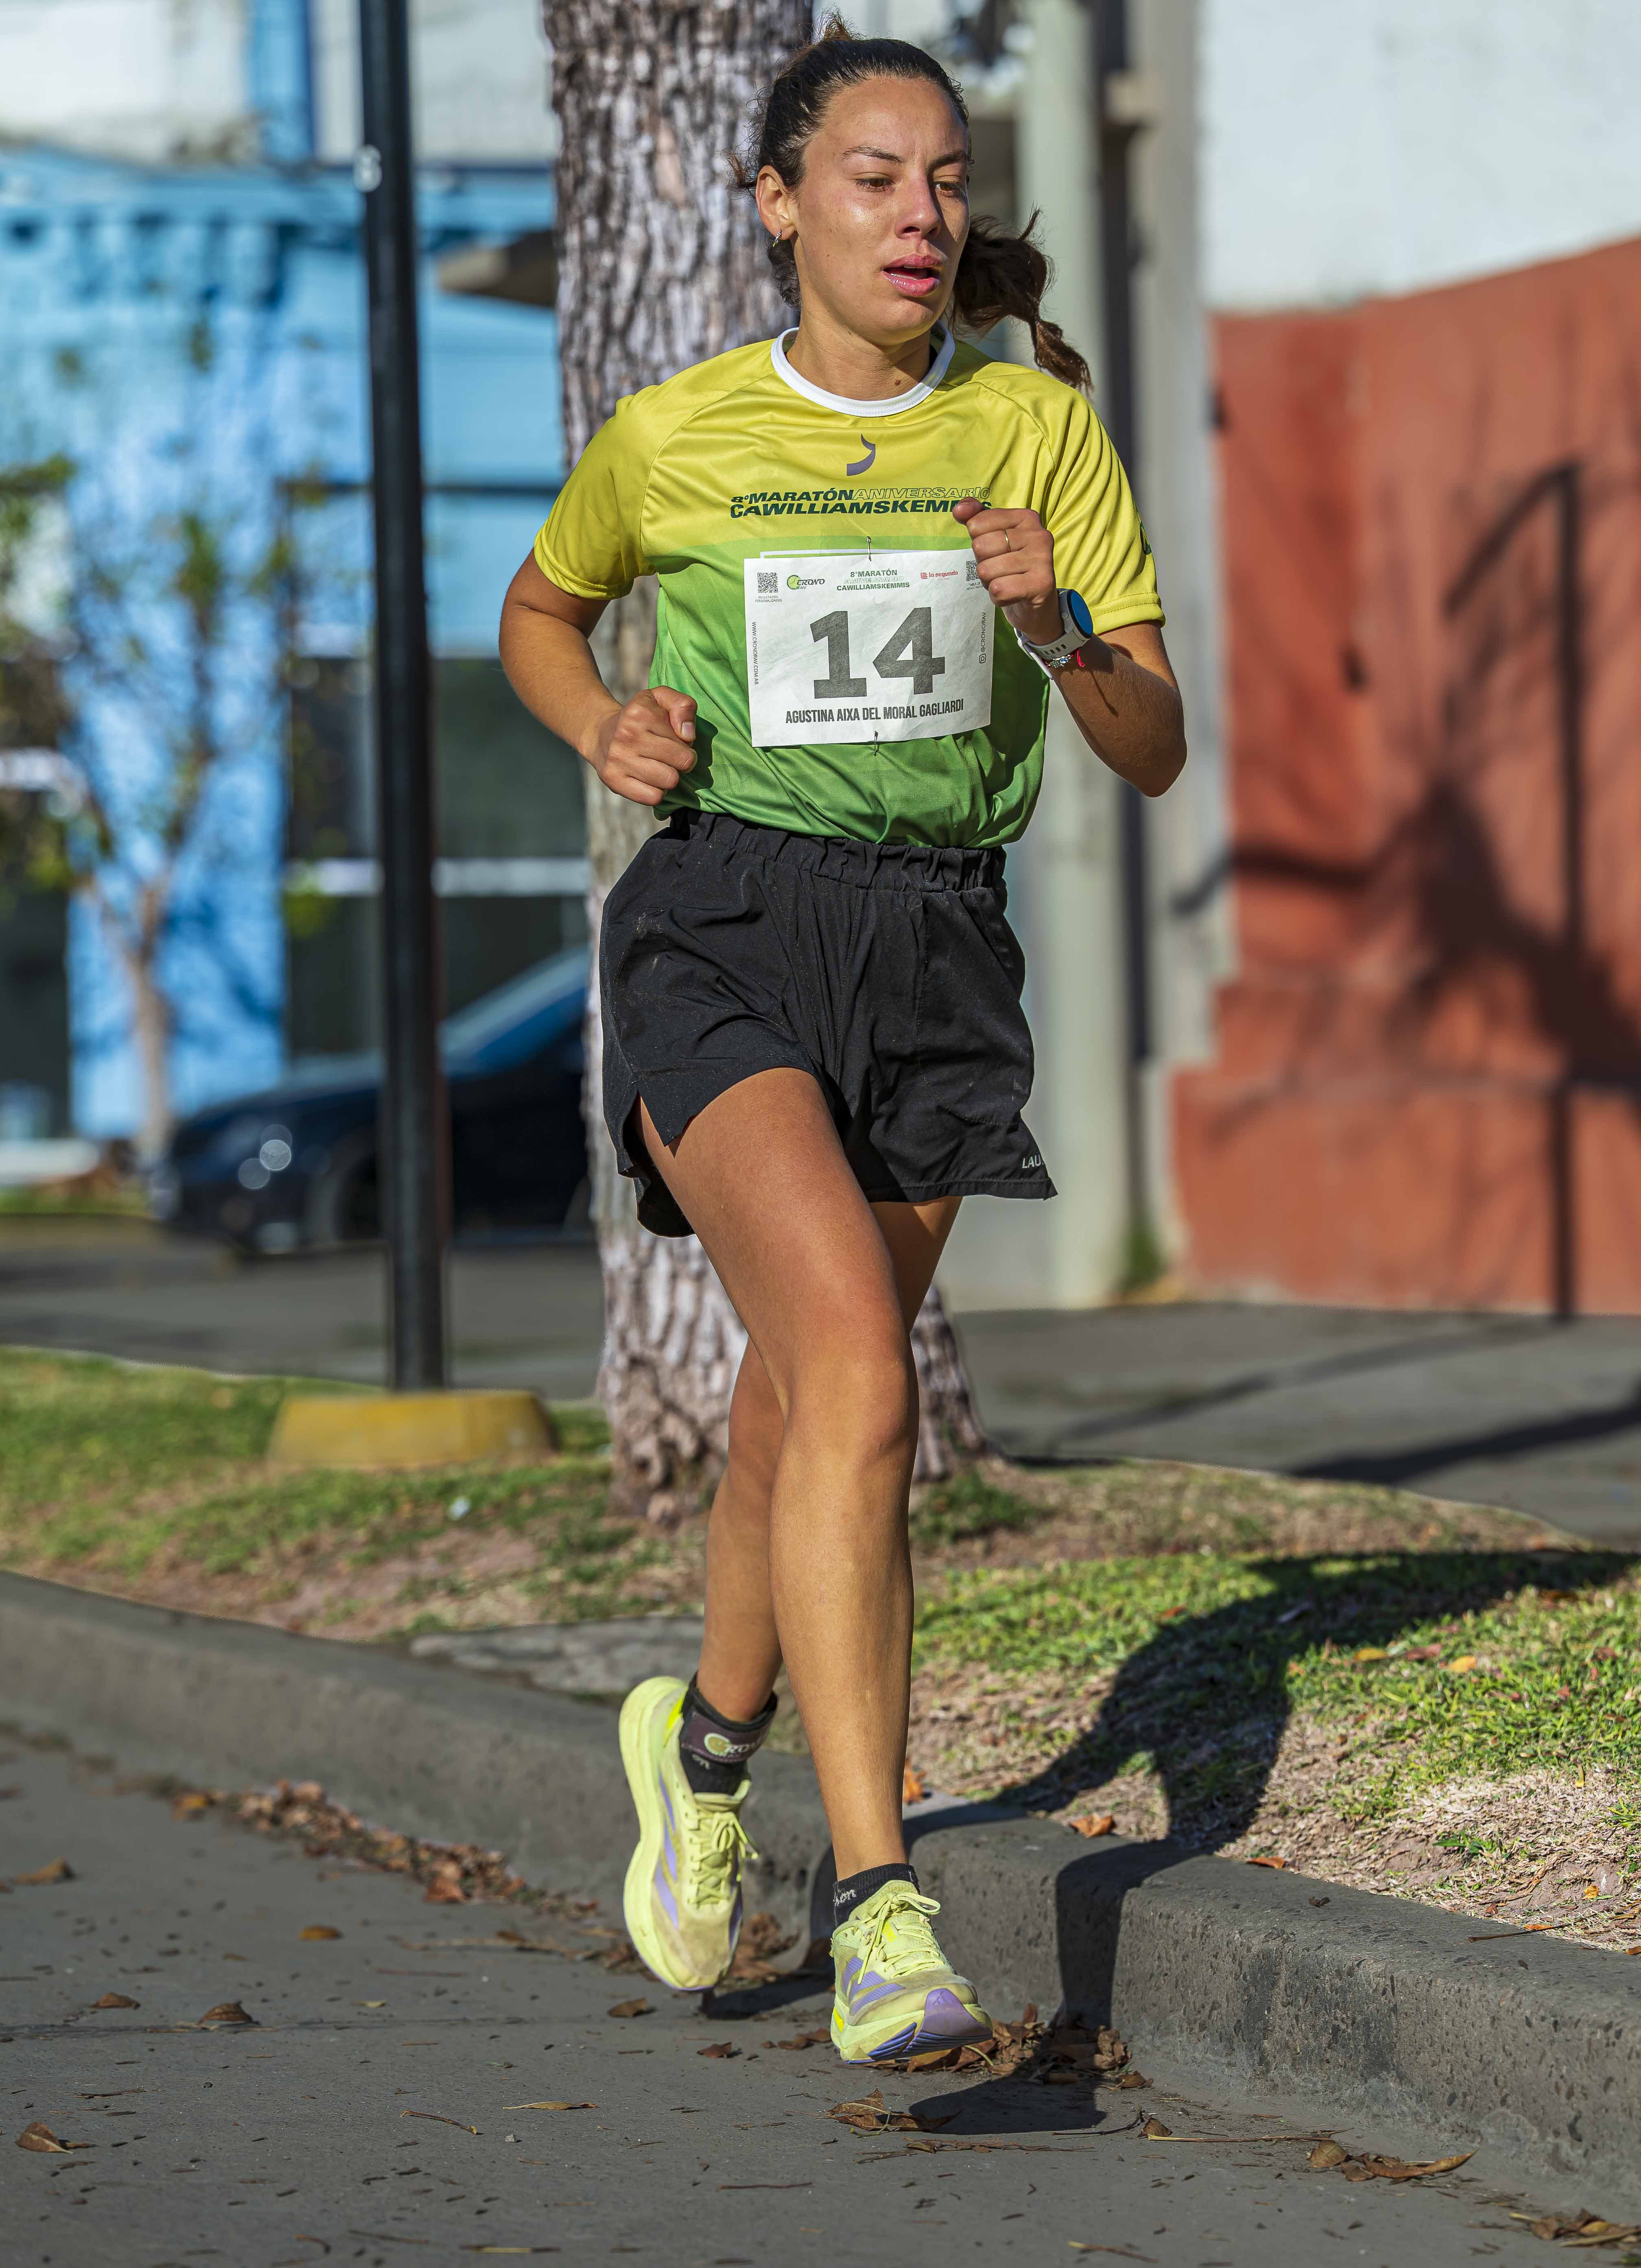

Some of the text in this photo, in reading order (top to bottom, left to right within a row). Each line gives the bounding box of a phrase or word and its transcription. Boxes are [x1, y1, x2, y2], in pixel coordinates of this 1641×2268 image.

[730, 500, 992, 518] CAWILLIAMSKEMS
[837, 582, 910, 591] CAWILLIAMSKEMMIS
[810, 607, 945, 699] 14
[785, 698, 964, 723] AGUSTINA AIXA DEL MORAL GAGLIARDI
[1022, 1154, 1044, 1169] LAU
